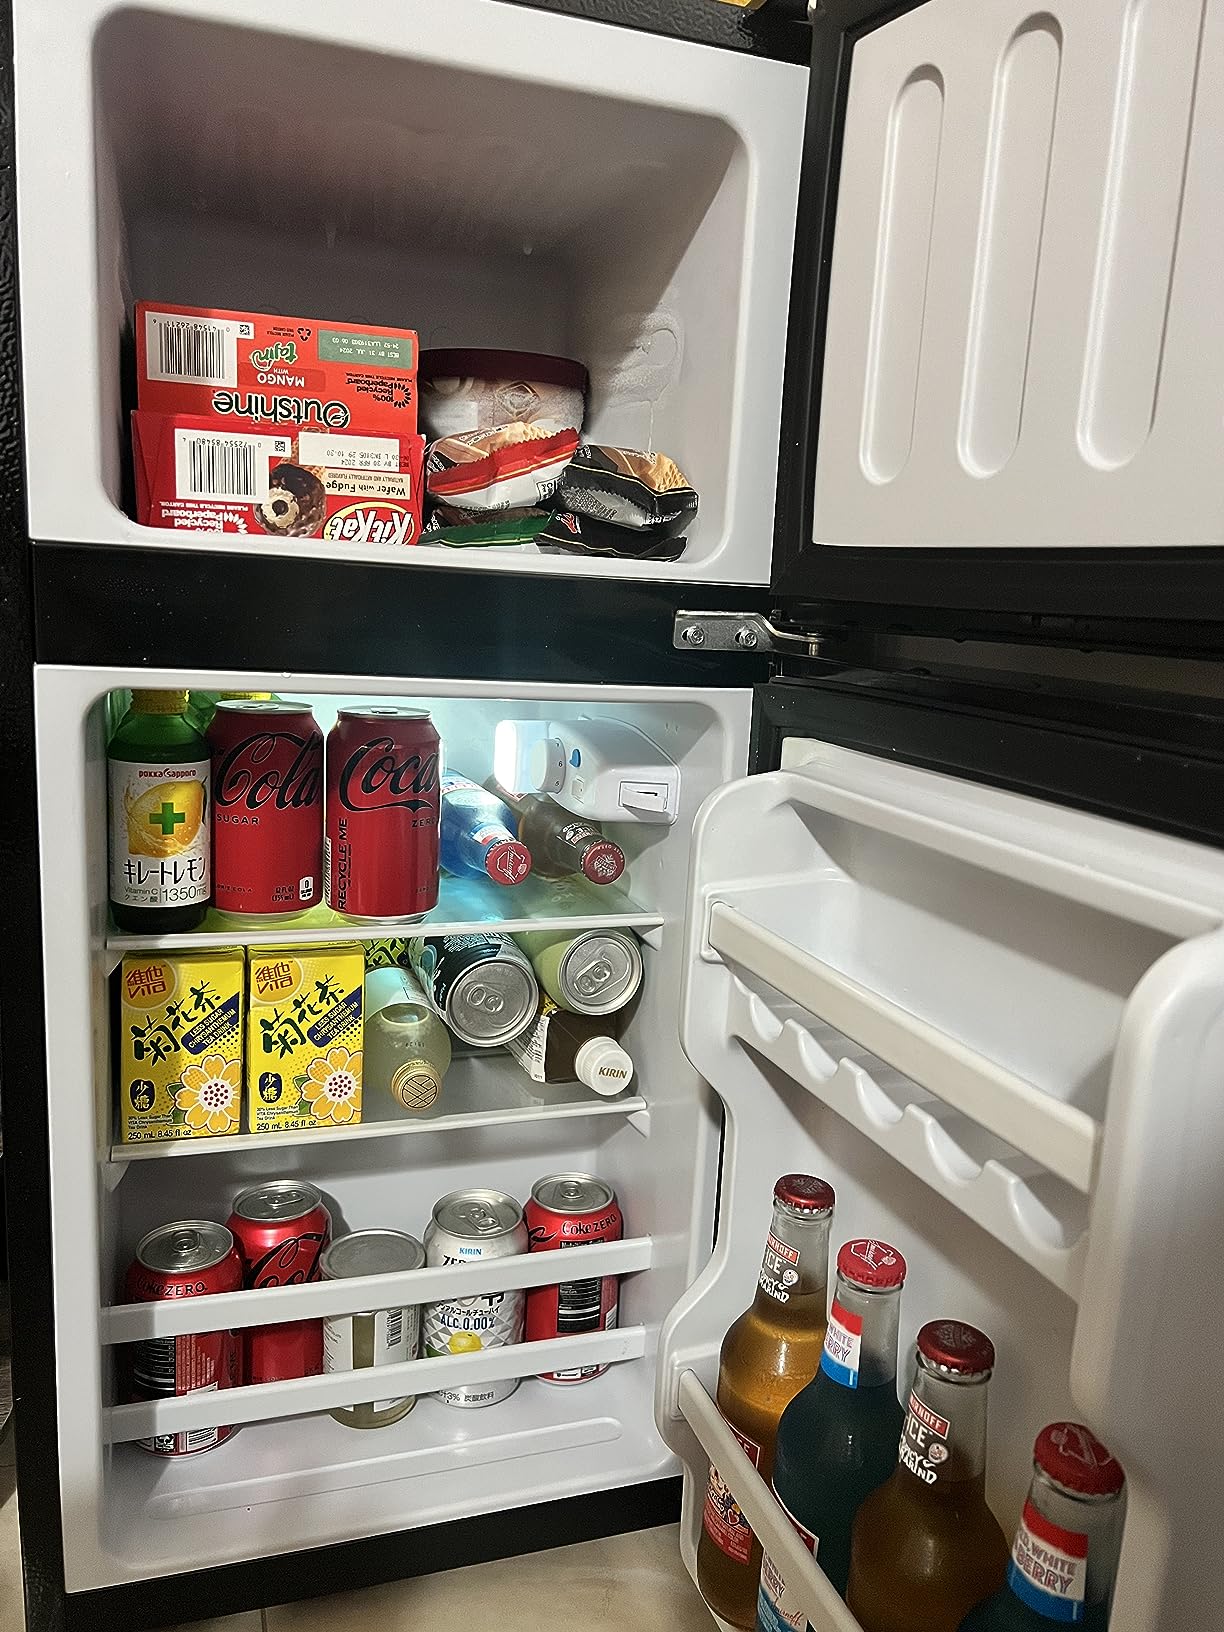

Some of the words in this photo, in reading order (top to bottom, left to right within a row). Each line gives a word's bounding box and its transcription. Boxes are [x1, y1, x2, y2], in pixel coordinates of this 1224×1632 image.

[257, 373, 305, 388] MANGO
[346, 378, 394, 389] Paperboard
[356, 385, 393, 396] Recycled
[372, 393, 394, 403] 100%
[213, 391, 350, 428] Outshine
[224, 440, 248, 449] 72554
[325, 480, 356, 493] Fudge
[358, 484, 375, 492] with
[376, 485, 406, 496] Wafer
[161, 509, 223, 520] Paperboard
[174, 517, 223, 528] Recycled
[329, 509, 413, 545] KitKat
[214, 730, 322, 810] Cola
[558, 760, 563, 768] 6
[339, 736, 439, 812] Coca
[216, 813, 260, 825] SUGAR
[338, 817, 348, 841] ME
[123, 857, 206, 886] キレートレモン
[338, 844, 348, 911] RECYCLE
[130, 980, 221, 1067] 菊花茶
[189, 1022, 206, 1039] LESS
[204, 1008, 224, 1027] SUGAR
[260, 974, 345, 1060] 菊花茶
[314, 1016, 330, 1031] LESS
[328, 1001, 348, 1020] SUGAR
[188, 1008, 237, 1048] CHRYSANTHEMUM
[202, 1033, 215, 1047] TEA
[214, 1021, 233, 1038] DRINK
[327, 1026, 341, 1039] TEA
[338, 1014, 356, 1031] DRINK
[598, 1066, 628, 1079] KIRIN
[256, 1122, 270, 1131] 250
[271, 1122, 283, 1130] mL
[284, 1120, 300, 1129] 8.45
[127, 1131, 142, 1141] 250
[143, 1130, 155, 1139] mL
[157, 1129, 174, 1138] 8.45
[562, 1220, 592, 1236] Coke
[593, 1213, 617, 1232] ZERO
[459, 1247, 482, 1256] KIRIN
[165, 1281, 206, 1296] ZERO
